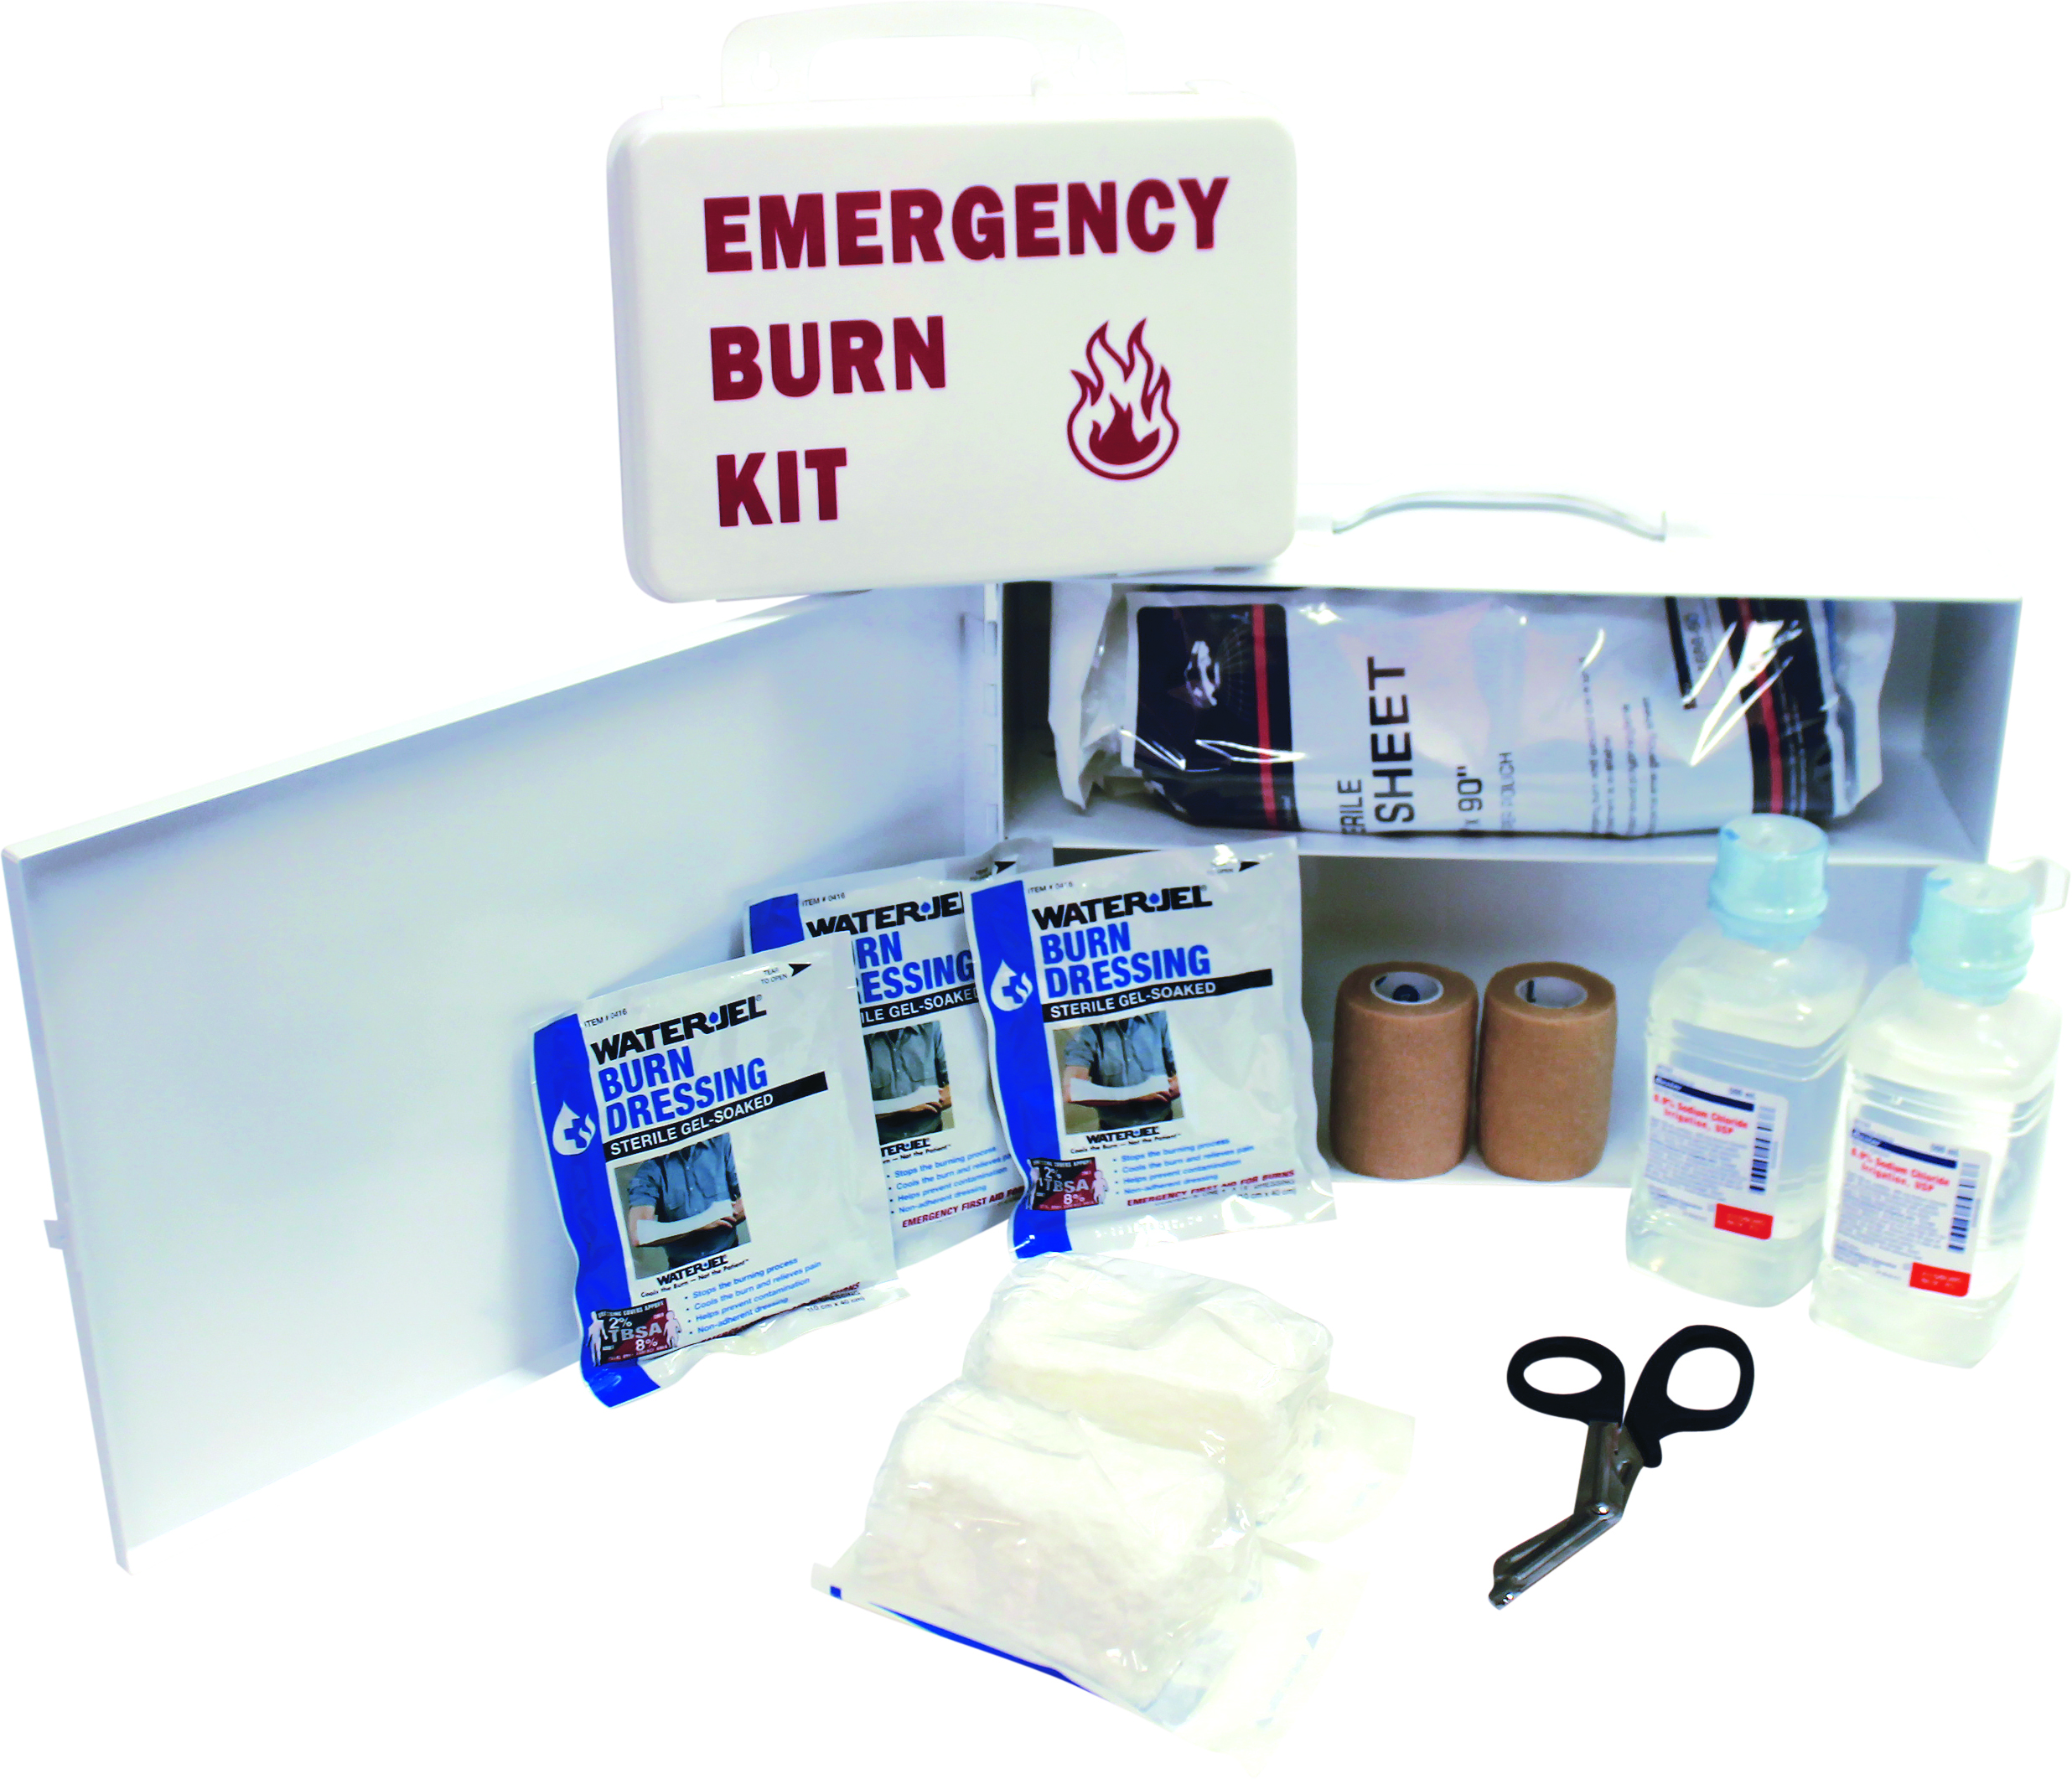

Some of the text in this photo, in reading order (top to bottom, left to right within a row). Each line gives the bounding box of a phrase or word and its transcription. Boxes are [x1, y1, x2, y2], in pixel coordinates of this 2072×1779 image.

[703, 176, 1230, 273] EMERGENCY
[709, 315, 946, 401] BURN
[716, 447, 847, 527] KIT
[1367, 656, 1415, 823] SHEET
[1457, 765, 1483, 812] 90"
[802, 897, 820, 907] ITEM
[828, 892, 846, 902] 0416
[852, 931, 903, 970] RN
[1039, 921, 1132, 965] BURN
[856, 949, 974, 1004] ESSING
[1044, 944, 1211, 999] DRESSING
[1049, 981, 1216, 1018] STERILE GEL-SOAKED
[583, 1014, 604, 1028] ITEM
[598, 1045, 694, 1102] BURN
[606, 1058, 768, 1135] DRESSING
[610, 1093, 774, 1156] STERILE GEL-SOAKED
[894, 1146, 997, 1179] Stops the burning process
[896, 1179, 920, 1191] Cools
[922, 1175, 935, 1184] the
[936, 1171, 955, 1181] burn
[956, 1166, 971, 1175] and
[898, 1166, 1008, 1202] Helps prevent contamination
[899, 1194, 952, 1213] Non-adherent
[1044, 1177, 1090, 1194] TBSA
[902, 1205, 959, 1228] EMERGENCY
[961, 1197, 987, 1212] FIRST
[989, 1192, 1005, 1202] AID
[692, 1258, 798, 1299] Stops the burning process
[694, 1261, 822, 1311] Cools the burn and relieves pain
[696, 1310, 720, 1322] Helps
[721, 1298, 752, 1315] prevent
[754, 1278, 811, 1302] contamination
[697, 1309, 754, 1333] Non-adherent
[754, 1297, 789, 1314] dressing
[607, 1321, 663, 1342] TBSA
[608, 1316, 633, 1330] 2%
[635, 1337, 659, 1352] 8%
